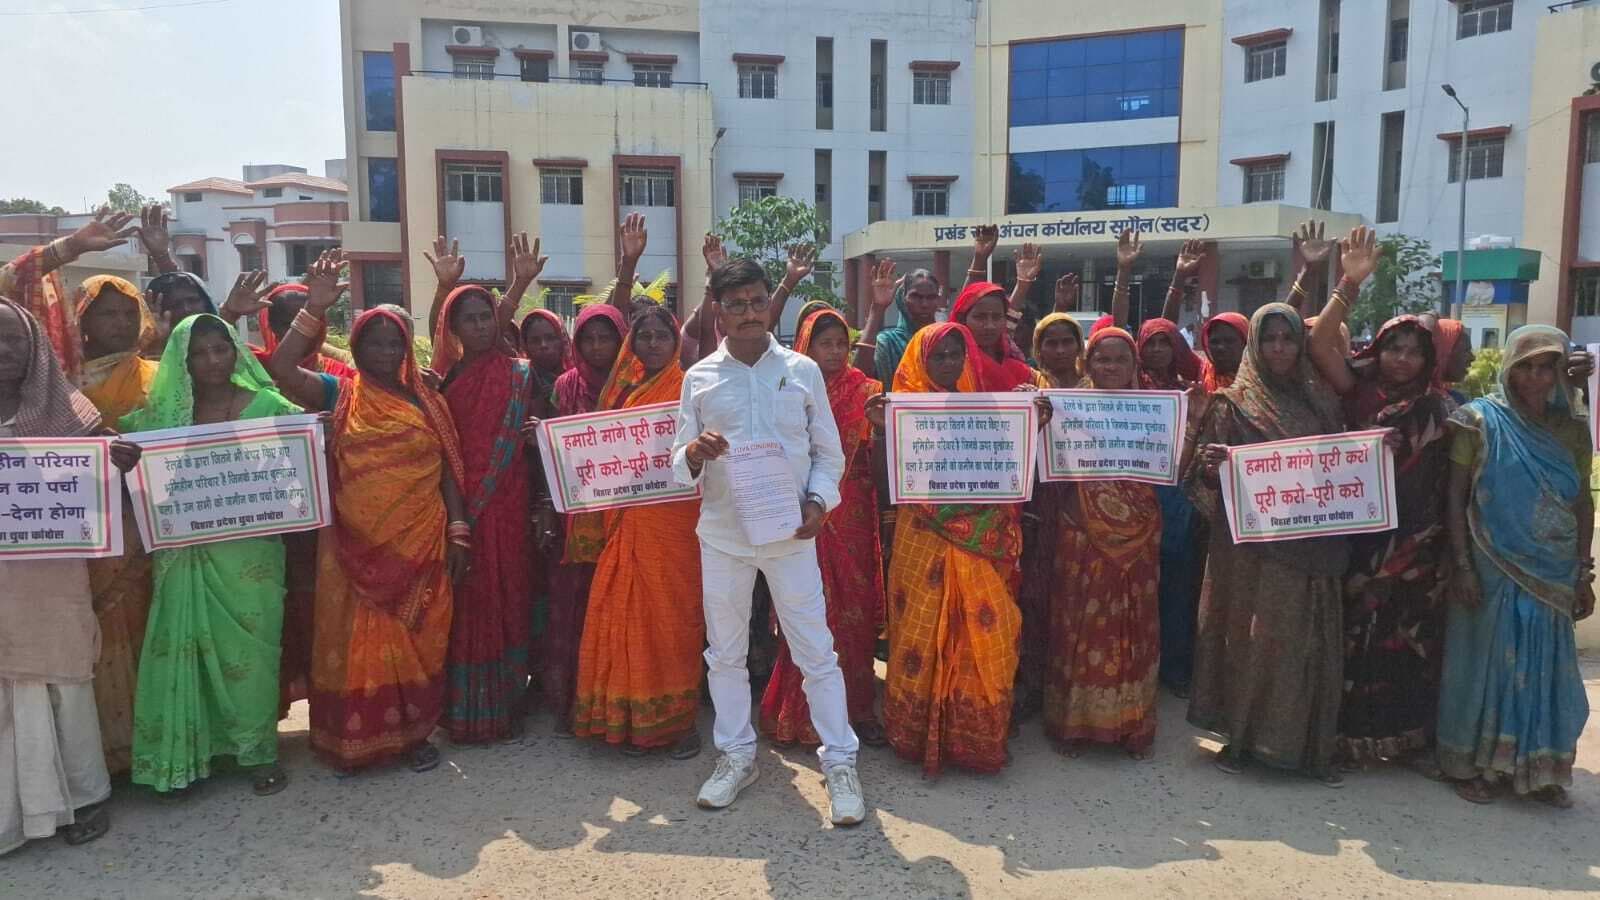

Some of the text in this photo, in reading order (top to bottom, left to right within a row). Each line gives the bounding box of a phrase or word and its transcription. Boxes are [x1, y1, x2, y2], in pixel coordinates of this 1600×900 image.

[934, 224, 968, 243] प्रखंड
[1000, 220, 1039, 239] अंचल
[562, 414, 676, 451] हमारी मांगे पूरी करो
[32, 451, 91, 468] परिवार
[183, 454, 193, 468] के
[576, 459, 597, 485] पूरी
[600, 450, 649, 479] करो-पूरी
[1244, 443, 1369, 476] हमारी मांगे पूरी करो
[16, 482, 40, 494] का
[46, 476, 78, 493] पर्चा
[194, 474, 219, 489] परिवार
[1255, 476, 1365, 513] पूरी करो-पूरी करो
[49, 502, 86, 519] होगा
